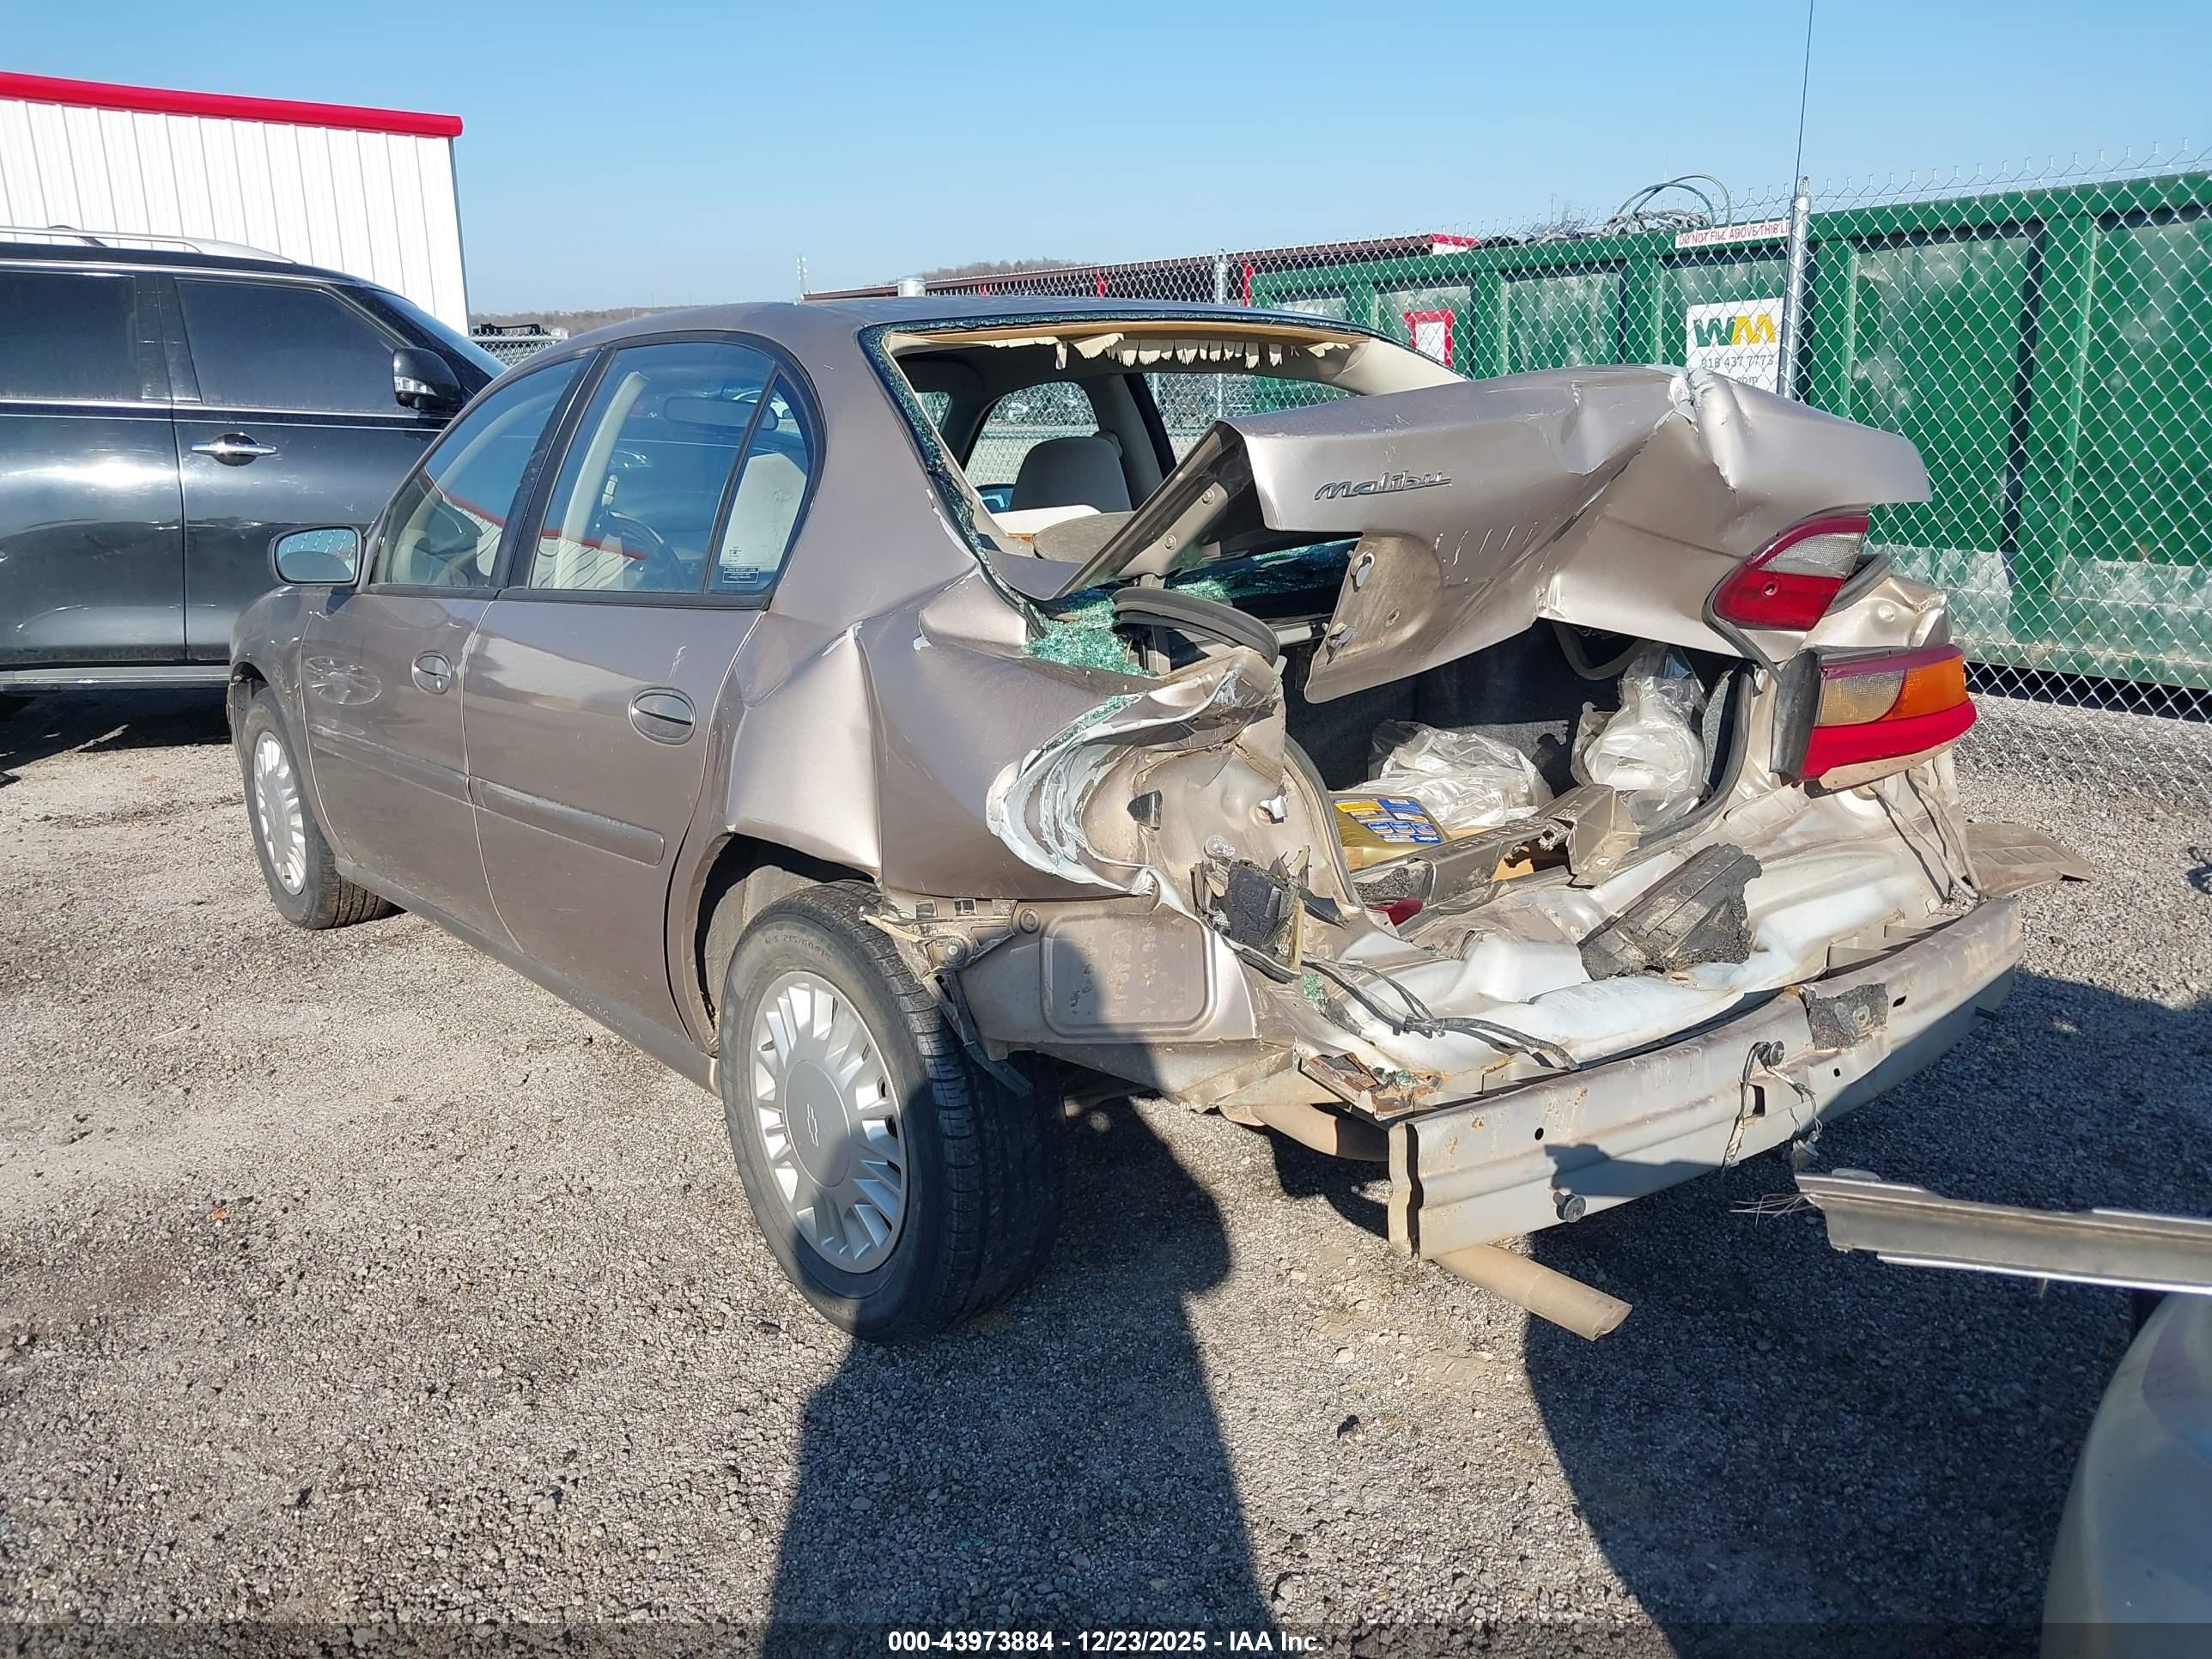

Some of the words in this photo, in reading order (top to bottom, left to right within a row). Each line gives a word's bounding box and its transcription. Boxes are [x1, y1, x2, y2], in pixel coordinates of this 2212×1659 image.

[1678, 234, 1690, 246] DO
[1692, 232, 1708, 244] NOT
[1711, 230, 1726, 242] FILL
[1729, 227, 1759, 240] ABOVE
[1760, 223, 1778, 236] THIS
[1692, 313, 1777, 348] WM
[1701, 357, 1721, 368] 918
[1723, 356, 1744, 368] 437
[1747, 355, 1774, 366] 7773
